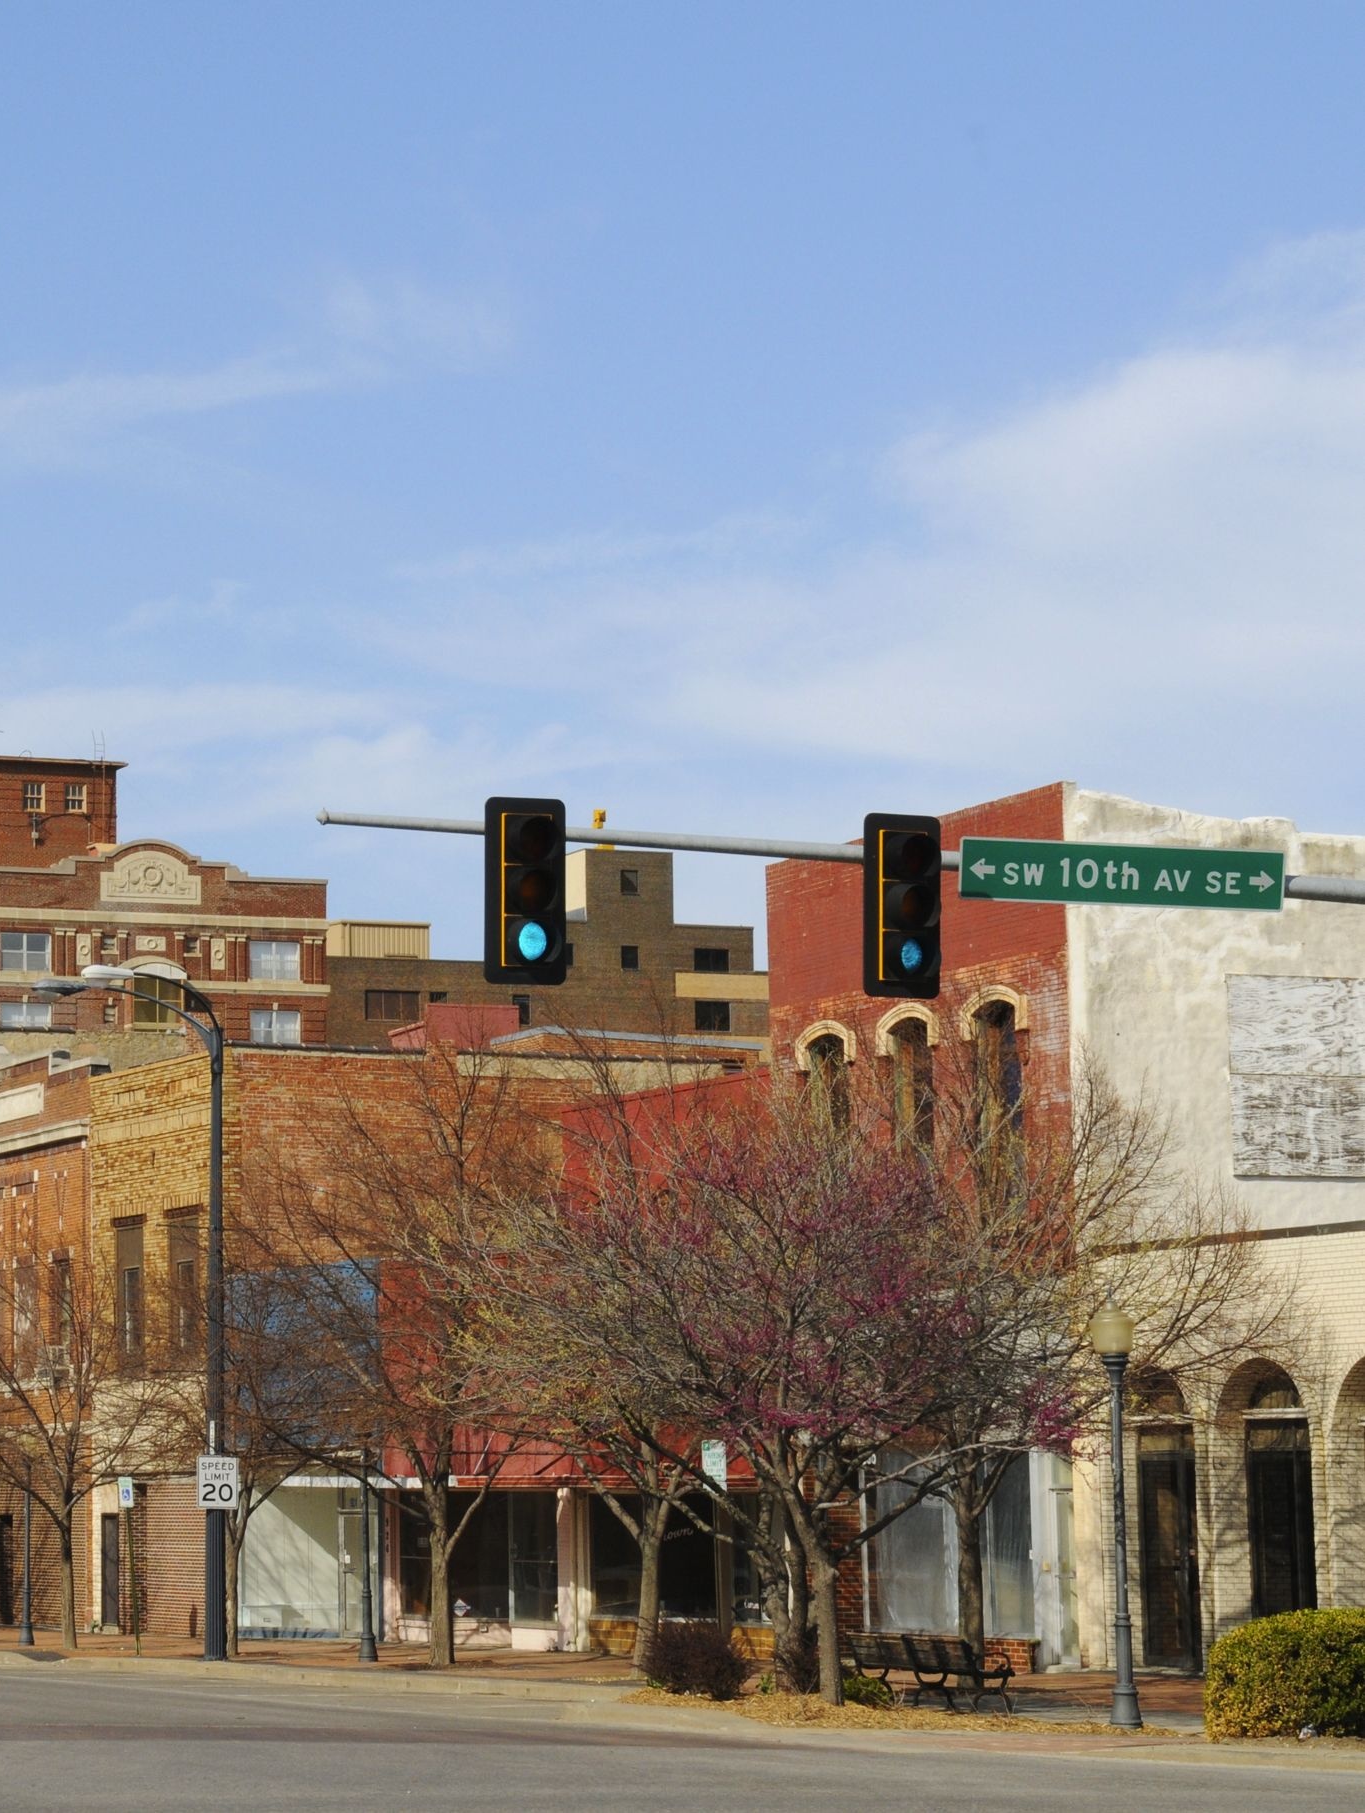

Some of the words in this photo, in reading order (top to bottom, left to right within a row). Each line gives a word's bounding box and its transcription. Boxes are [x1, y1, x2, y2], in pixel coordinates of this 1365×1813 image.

[1002, 862, 1045, 886] SW
[1060, 857, 1140, 891] 10th
[1153, 869, 1192, 892] AV
[1205, 870, 1241, 895] SE
[201, 1462, 235, 1471] SPEED
[204, 1473, 230, 1481] LIMIT
[202, 1483, 233, 1502] 20
